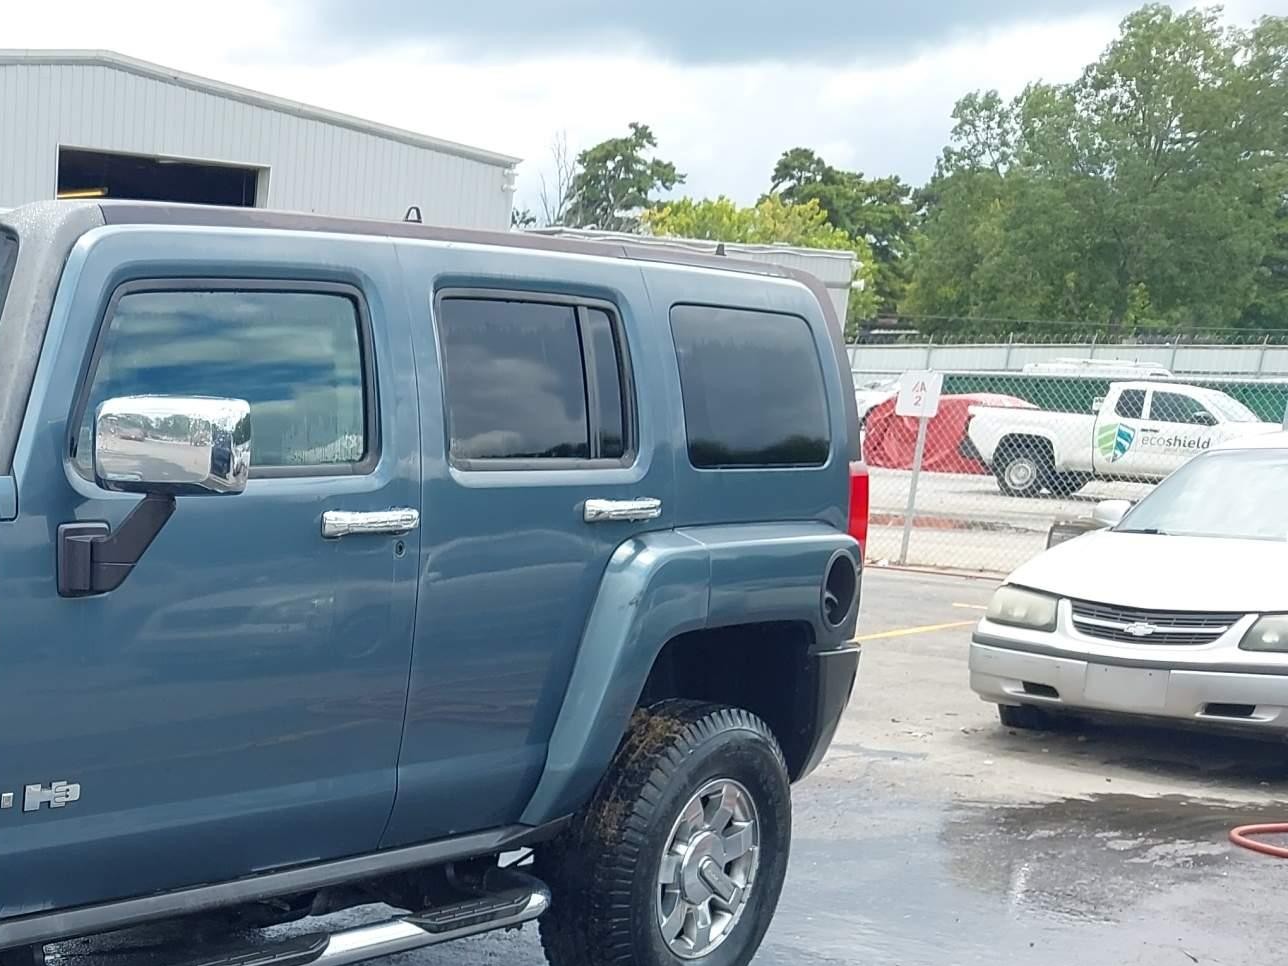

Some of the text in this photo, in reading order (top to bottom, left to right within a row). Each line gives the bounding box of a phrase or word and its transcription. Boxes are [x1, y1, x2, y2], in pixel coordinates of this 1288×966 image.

[913, 395, 922, 407] 2
[1140, 434, 1212, 450] ecoshield
[23, 780, 81, 812] H3
